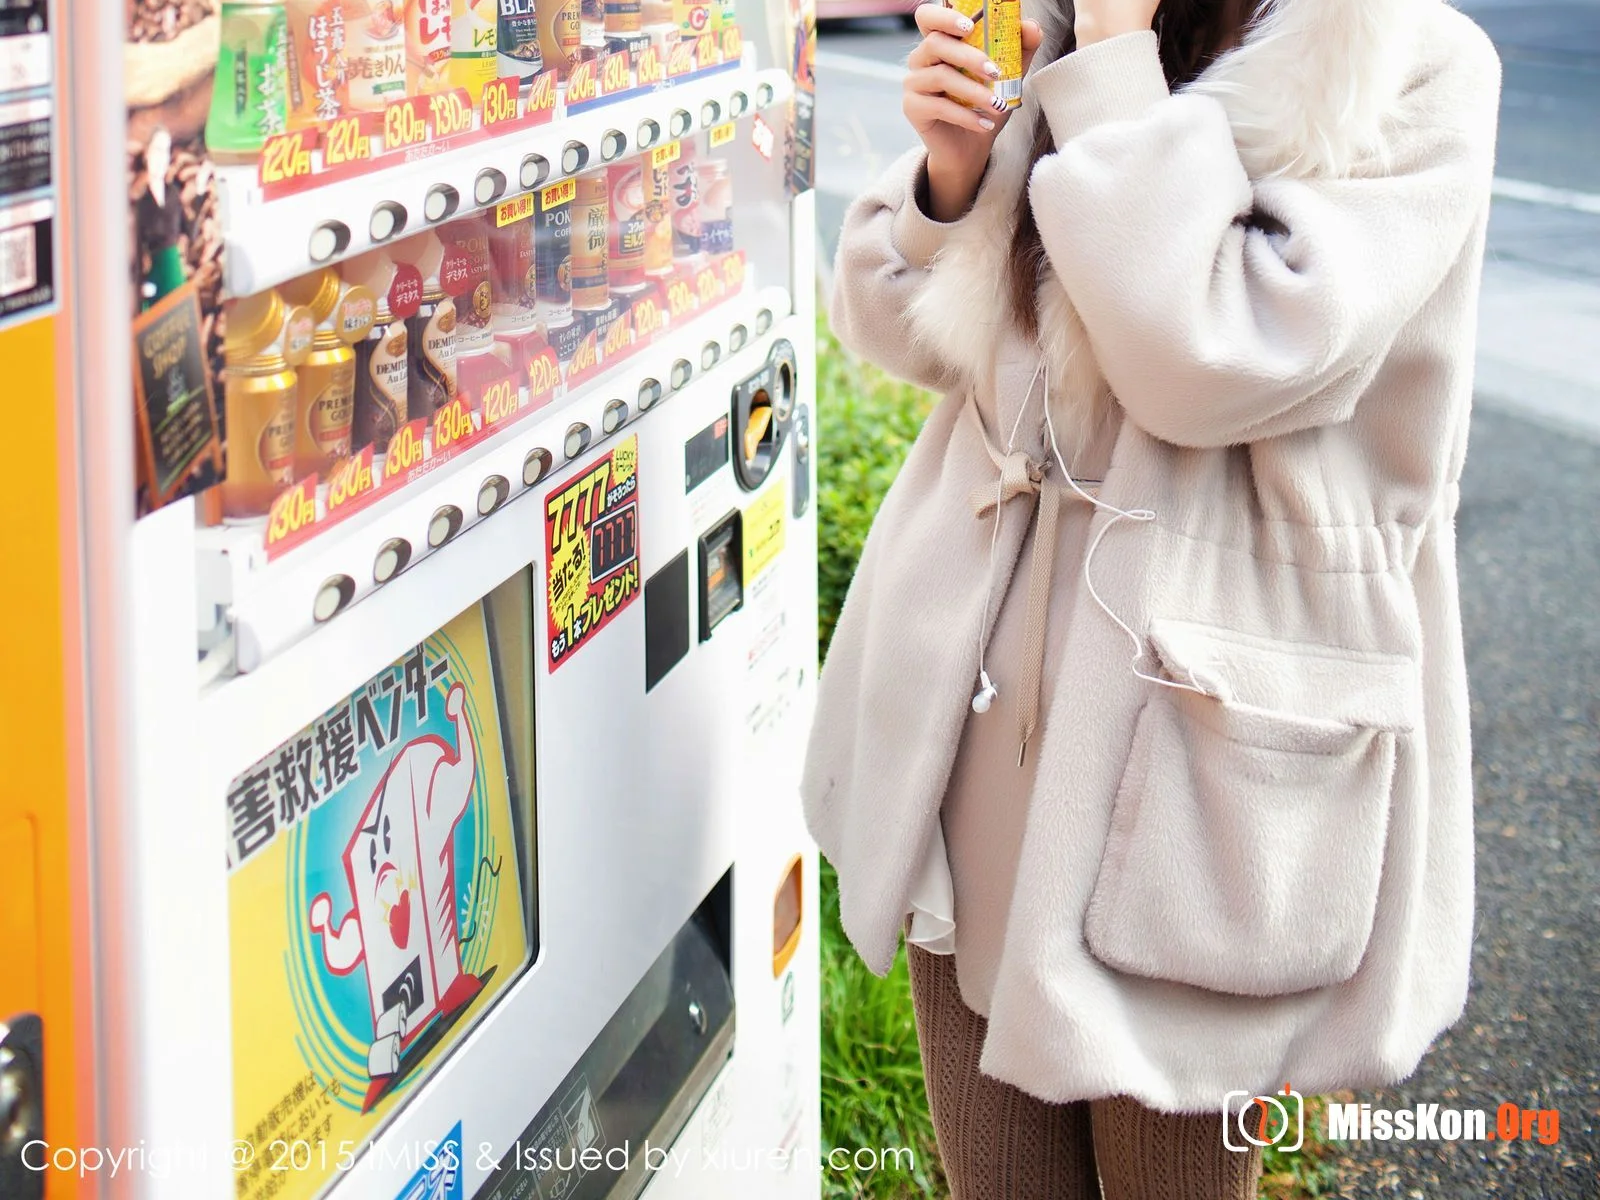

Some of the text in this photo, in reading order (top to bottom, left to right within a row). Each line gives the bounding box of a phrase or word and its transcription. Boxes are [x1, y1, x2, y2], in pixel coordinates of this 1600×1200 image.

[474, 28, 497, 49] レモ
[309, 15, 340, 120] ほうじ茶
[604, 56, 630, 92] 130円
[431, 93, 472, 135] 130円
[483, 83, 516, 126] 130円
[528, 75, 557, 112] 130円
[327, 118, 371, 165] 120円
[385, 103, 427, 149] 130円
[262, 134, 312, 184] 120円
[500, 197, 533, 222] お買い得!!
[545, 181, 575, 206] お買い得!!
[396, 289, 420, 305] デミタス
[446, 268, 469, 284] デミタス
[428, 335, 457, 350] DEMIT
[530, 354, 560, 399] 120円
[435, 400, 473, 449] 130円
[483, 380, 518, 425] 120円
[385, 426, 424, 479] 130円
[615, 449, 636, 462] LUCKY
[329, 455, 371, 510] 130円
[268, 486, 314, 545] 130円
[548, 461, 611, 552] 7777
[552, 538, 587, 602] 当たる!
[552, 560, 639, 658] もう1本プレゼント!
